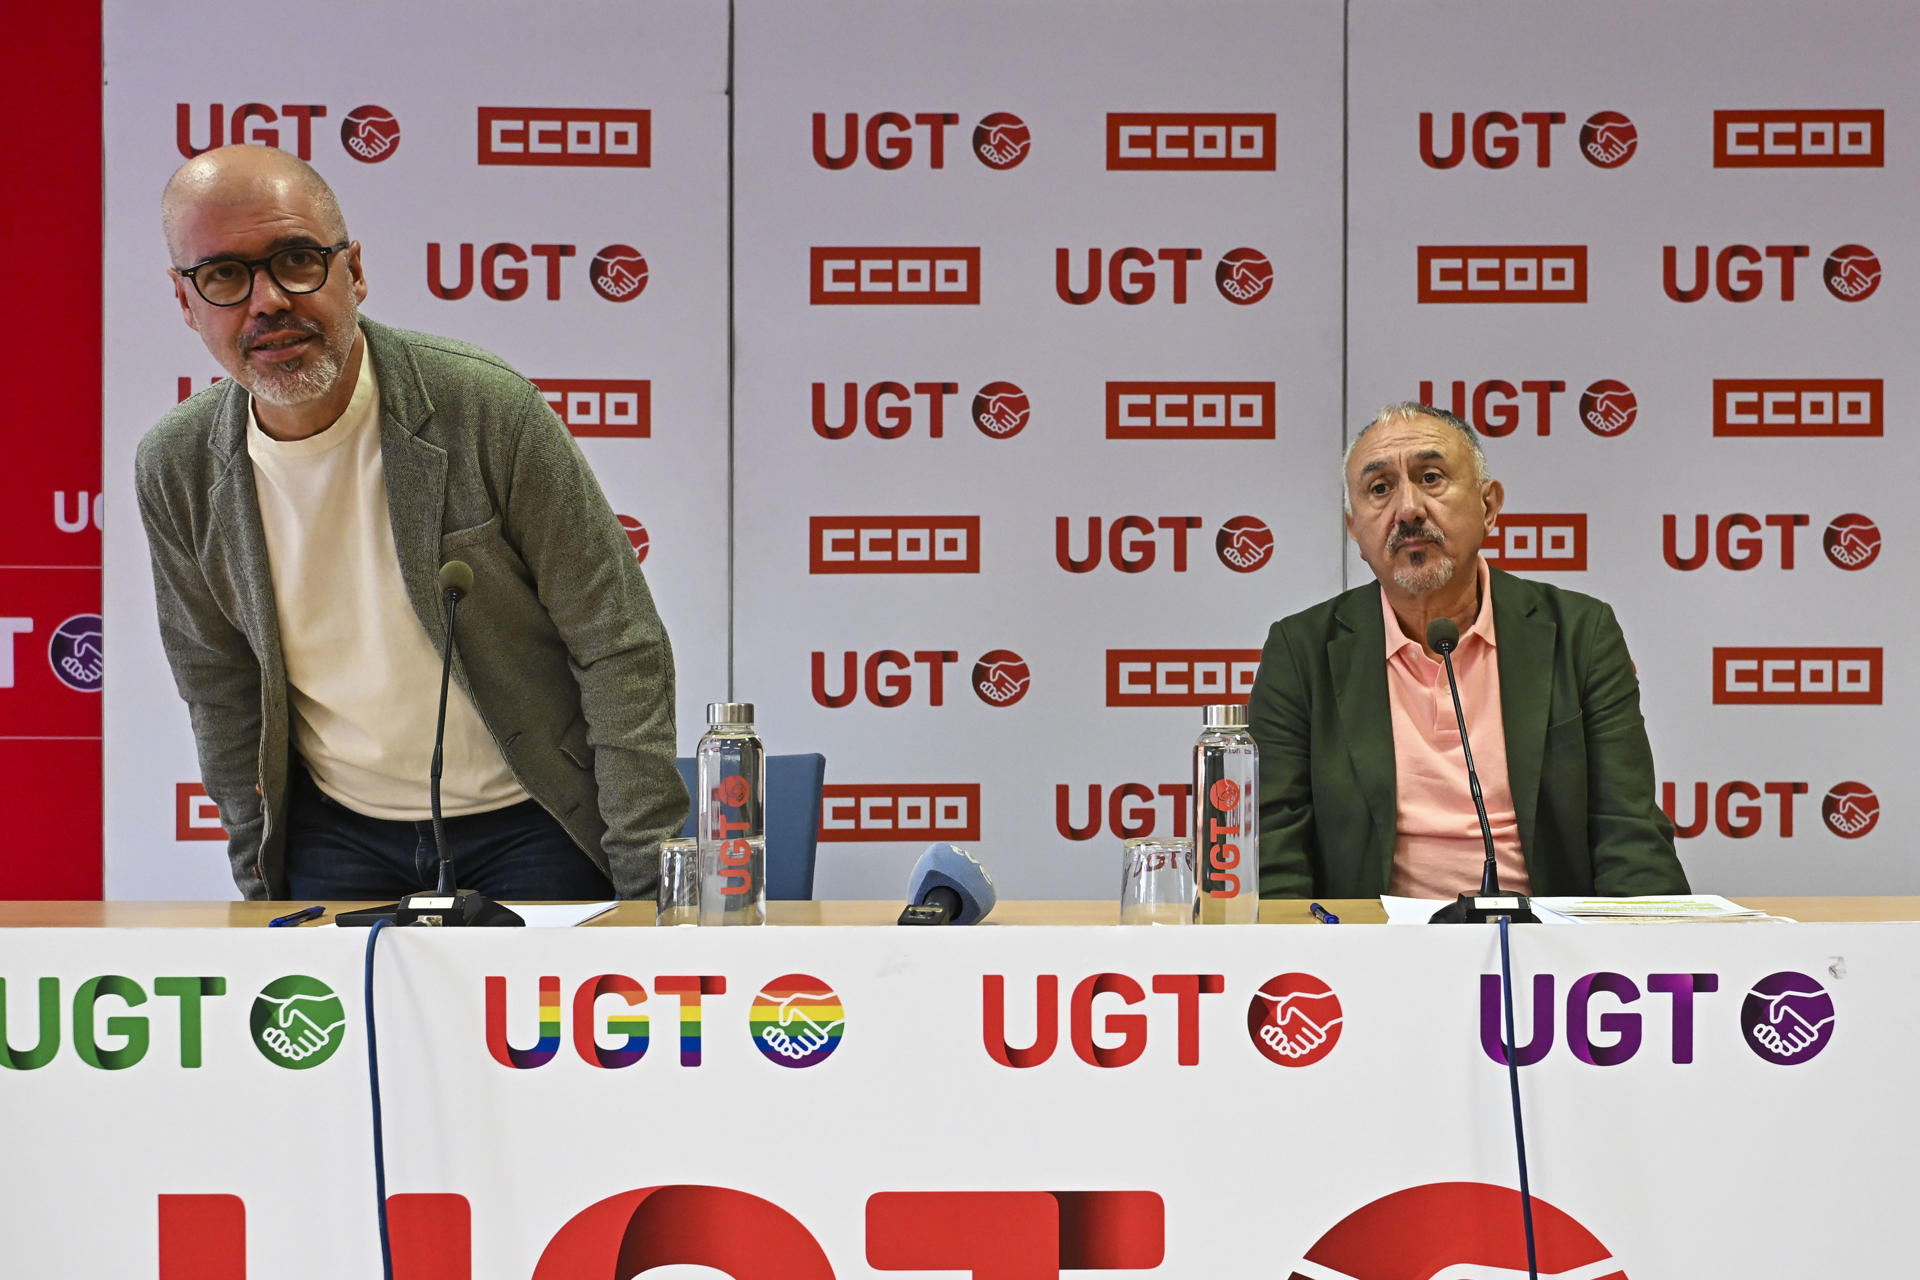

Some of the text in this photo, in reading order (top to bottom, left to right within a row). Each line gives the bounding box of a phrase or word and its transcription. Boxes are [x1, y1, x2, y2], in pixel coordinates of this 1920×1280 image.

[177, 103, 327, 162] UGT
[491, 120, 638, 155] CCOO
[813, 113, 960, 170] UGT
[1119, 126, 1264, 160] CCOO
[1420, 112, 1567, 169] UGT
[1726, 123, 1871, 156] CCOO
[428, 243, 577, 301] UGT
[823, 260, 968, 293] CCOO
[1056, 248, 1203, 305] UGT
[1430, 259, 1575, 292] CCOO
[1664, 246, 1811, 303] UGT
[813, 382, 960, 440] UGT
[1119, 395, 1263, 428] CCOO
[1726, 391, 1871, 425] CCOO
[823, 529, 968, 562] CCOO
[1056, 516, 1203, 573] UGT
[1664, 514, 1811, 571] UGT
[812, 651, 960, 708] UGT
[1725, 660, 1870, 693] CCOO
[823, 796, 968, 830] CCOO
[1056, 783, 1194, 841] UGT
[1662, 782, 1809, 840] UGT
[719, 814, 752, 895] UGT
[1210, 817, 1241, 899] UGT
[0, 975, 227, 1070] UGT
[485, 974, 727, 1069] UGT
[982, 972, 1225, 1069] UGT
[1480, 972, 1719, 1067] UGT
